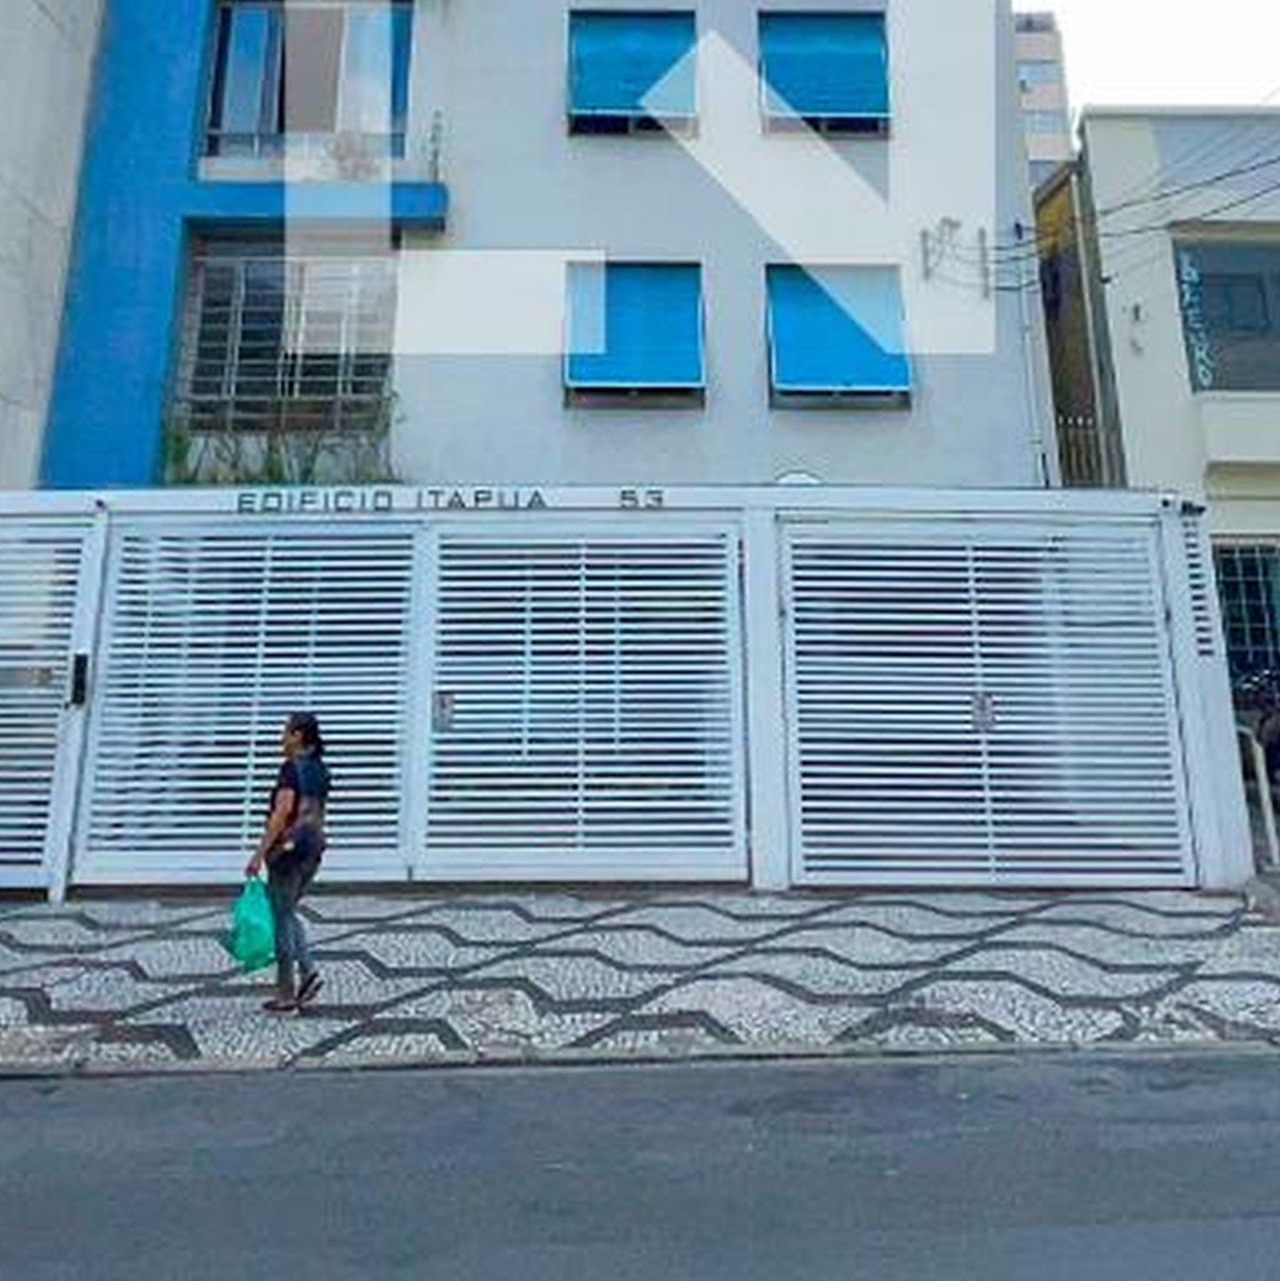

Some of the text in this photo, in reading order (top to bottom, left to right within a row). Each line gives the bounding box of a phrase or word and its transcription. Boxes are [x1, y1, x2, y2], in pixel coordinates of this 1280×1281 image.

[236, 488, 665, 514] EDIFICIO ITAPUA 53
